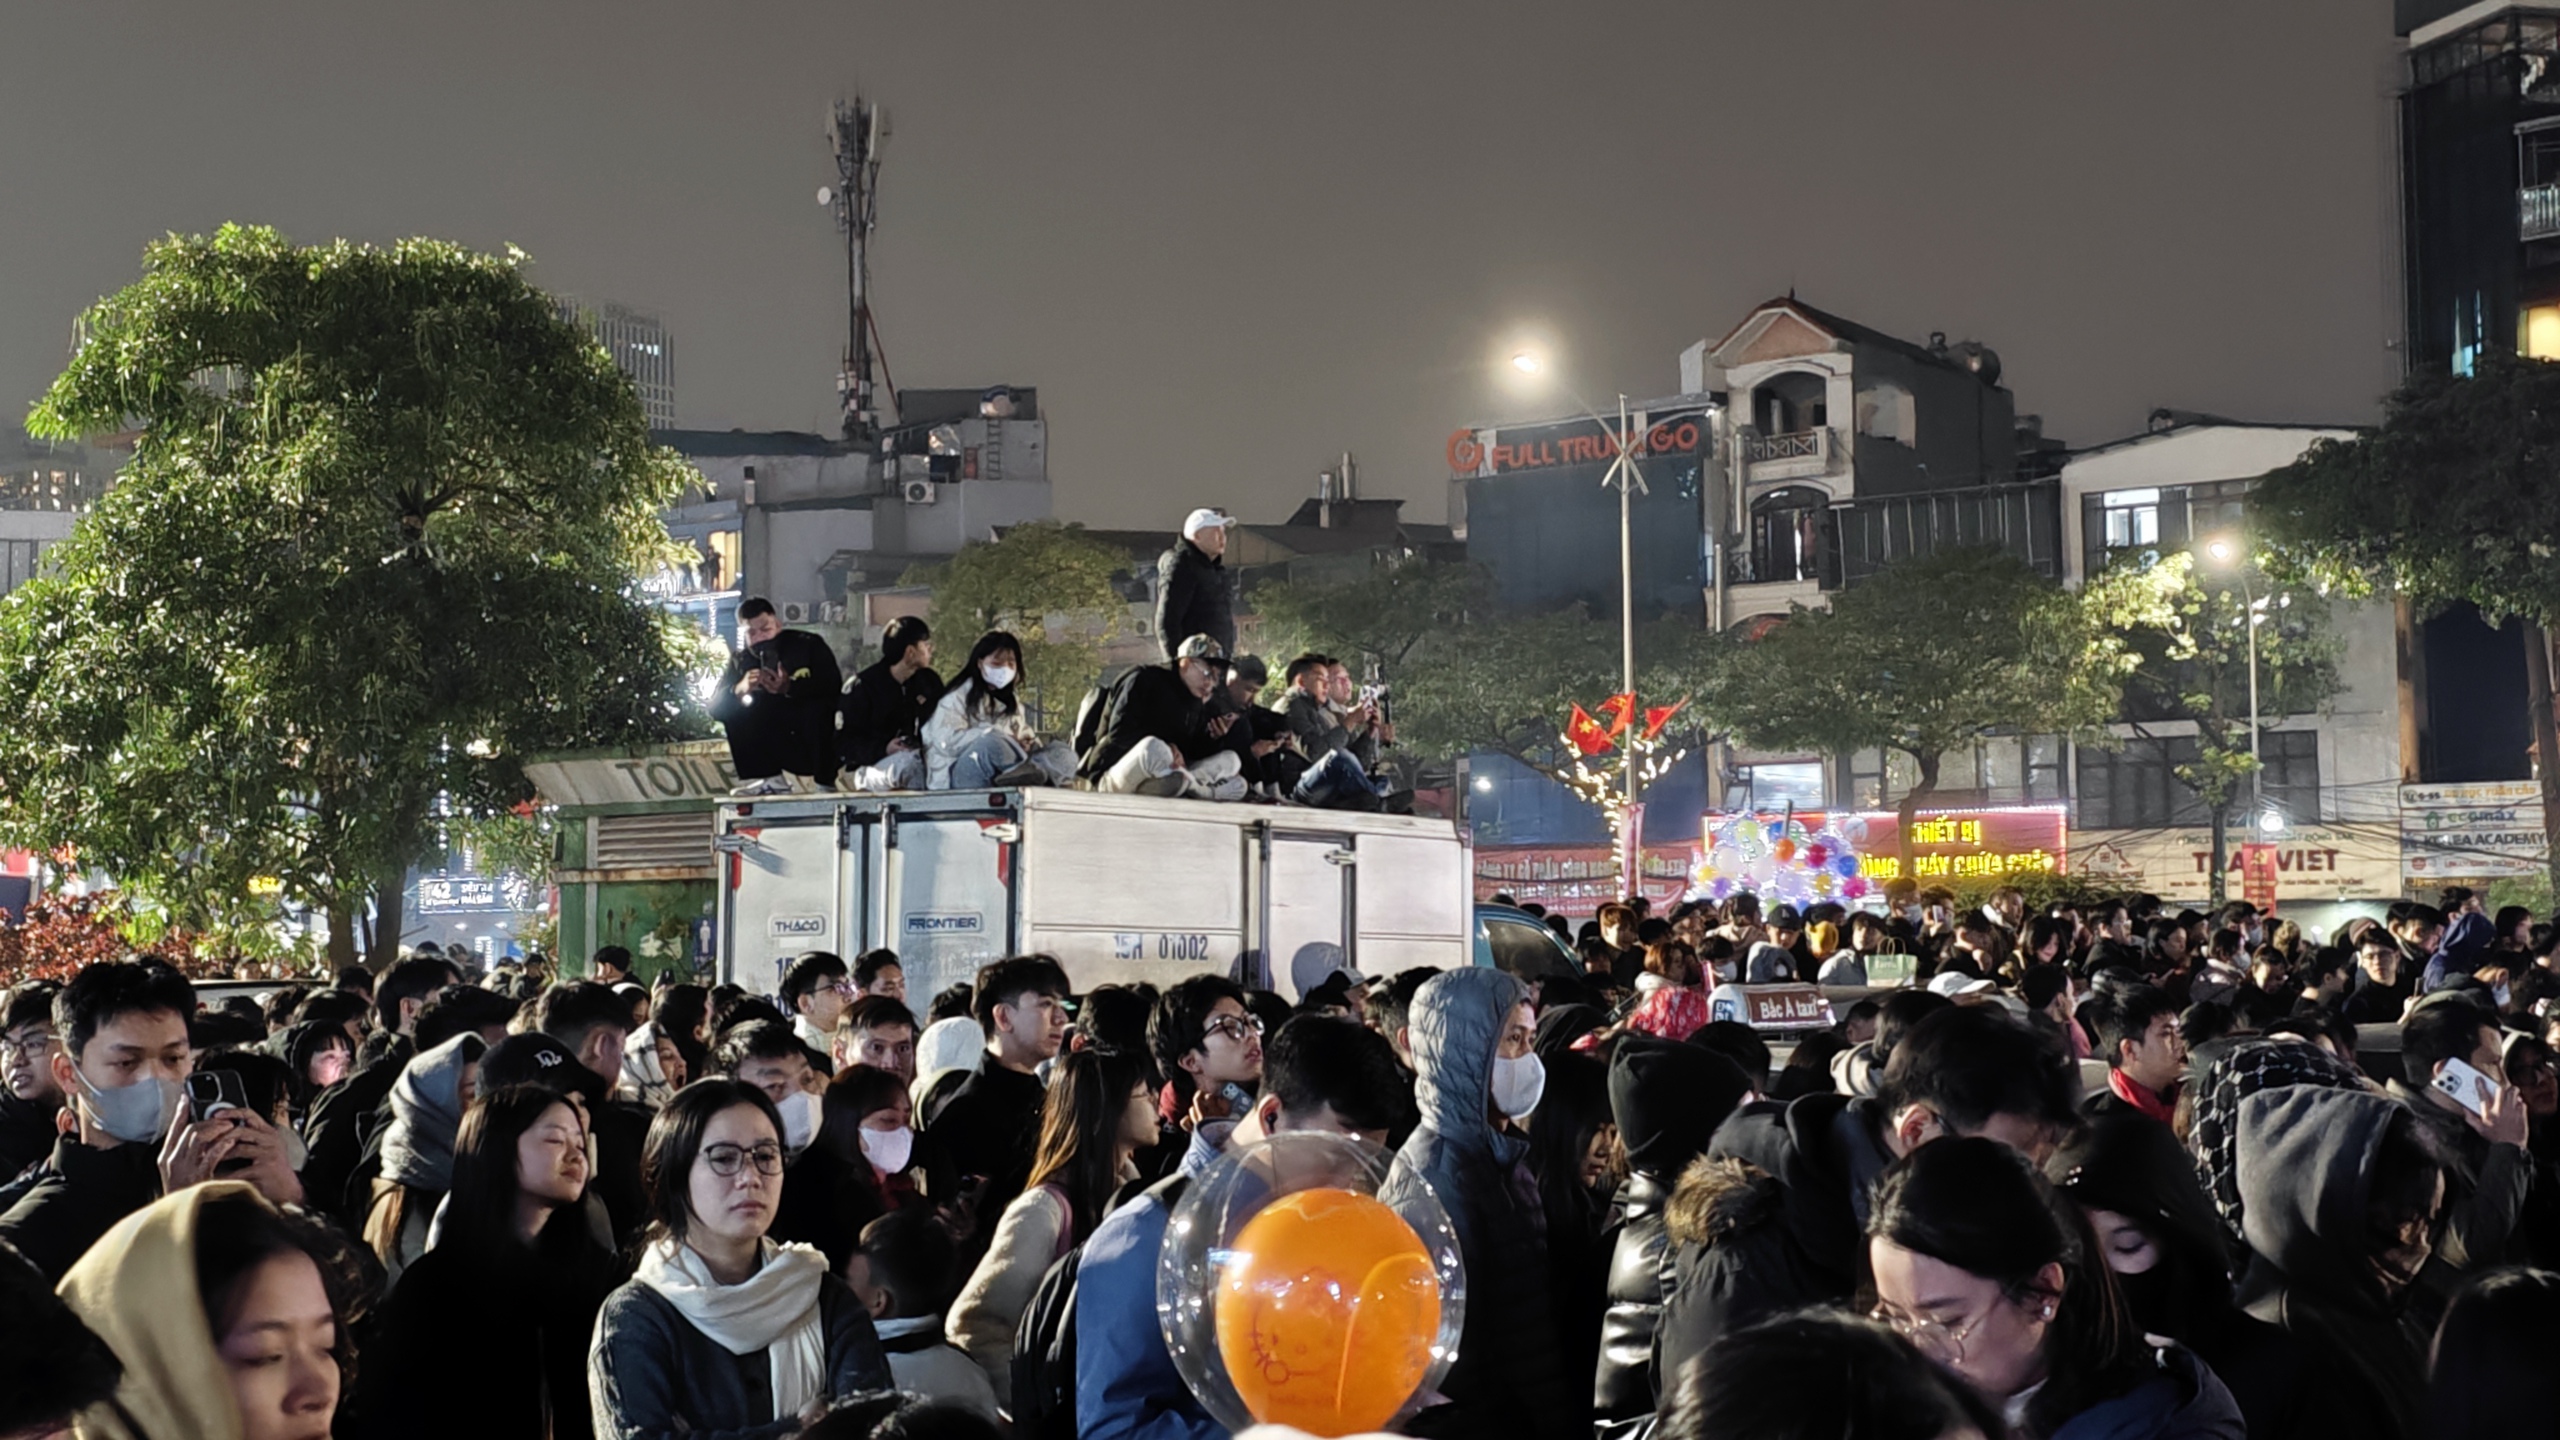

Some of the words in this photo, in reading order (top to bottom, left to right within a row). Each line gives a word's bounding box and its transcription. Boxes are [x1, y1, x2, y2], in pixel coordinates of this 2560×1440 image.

[1492, 441, 1556, 470] FULL
[1649, 422, 1699, 453] GO
[614, 758, 738, 800] TOILE
[1961, 819, 1981, 846] BỊ
[2474, 832, 2546, 845] ACADEMY
[1913, 852, 1950, 877] HÁY
[775, 920, 819, 933] THACO
[907, 916, 978, 930] FRONTIER
[1159, 932, 1208, 960] 01002
